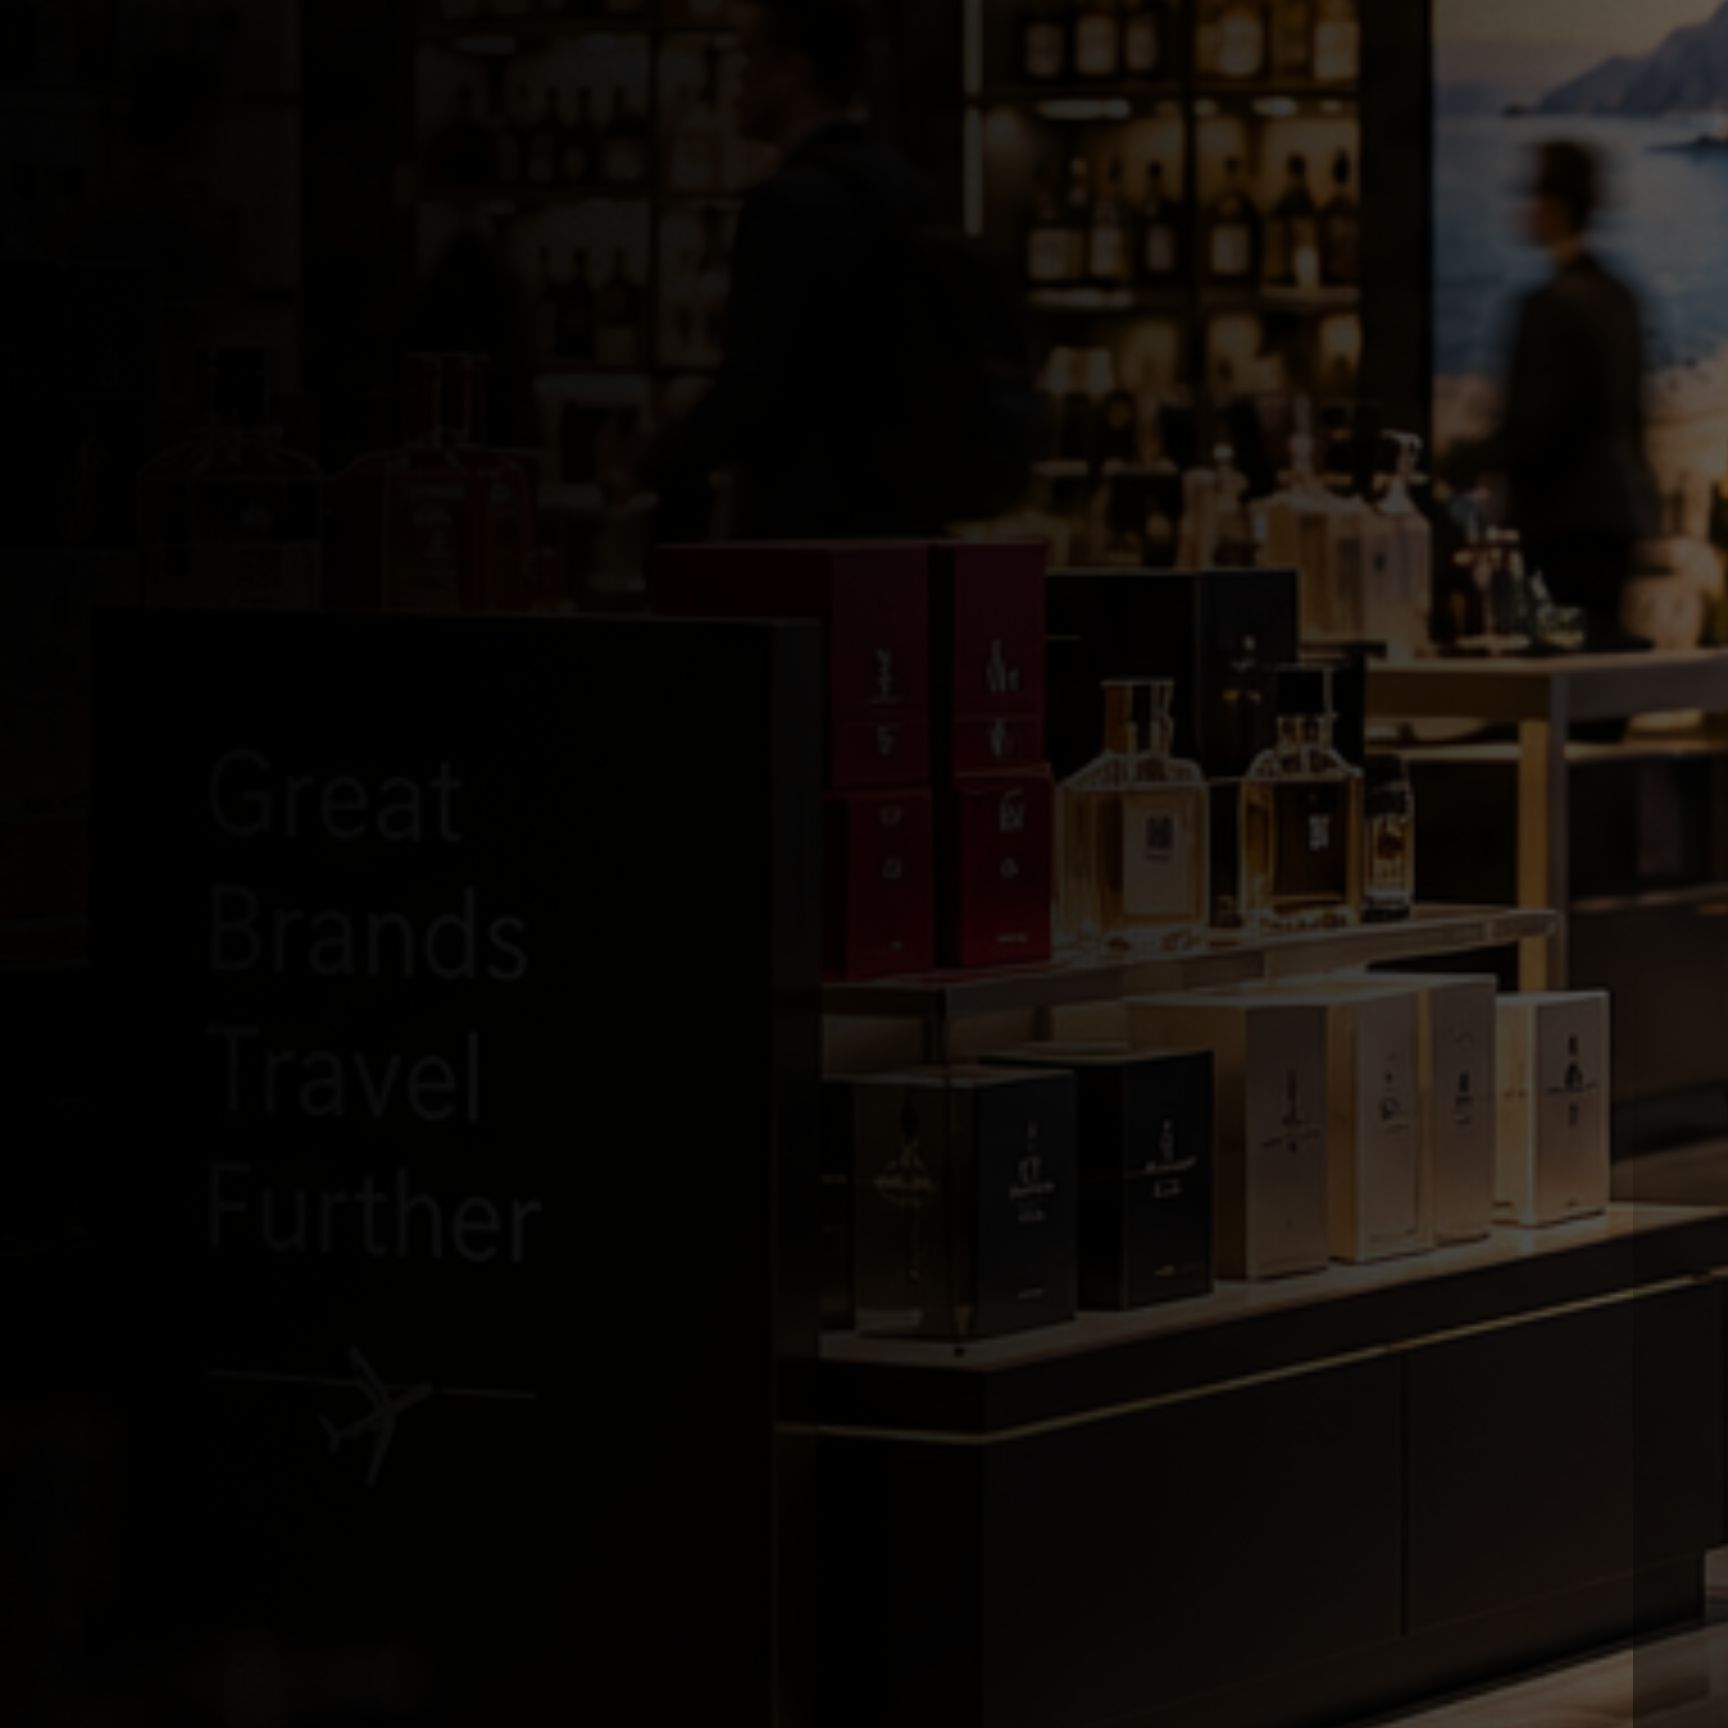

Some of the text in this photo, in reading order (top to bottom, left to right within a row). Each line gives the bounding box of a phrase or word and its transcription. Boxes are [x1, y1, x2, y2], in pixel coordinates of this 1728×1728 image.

[206, 746, 464, 845] Great
[208, 881, 530, 983] Brands
[206, 1022, 481, 1125] Travel
[207, 1161, 545, 1265] Further
